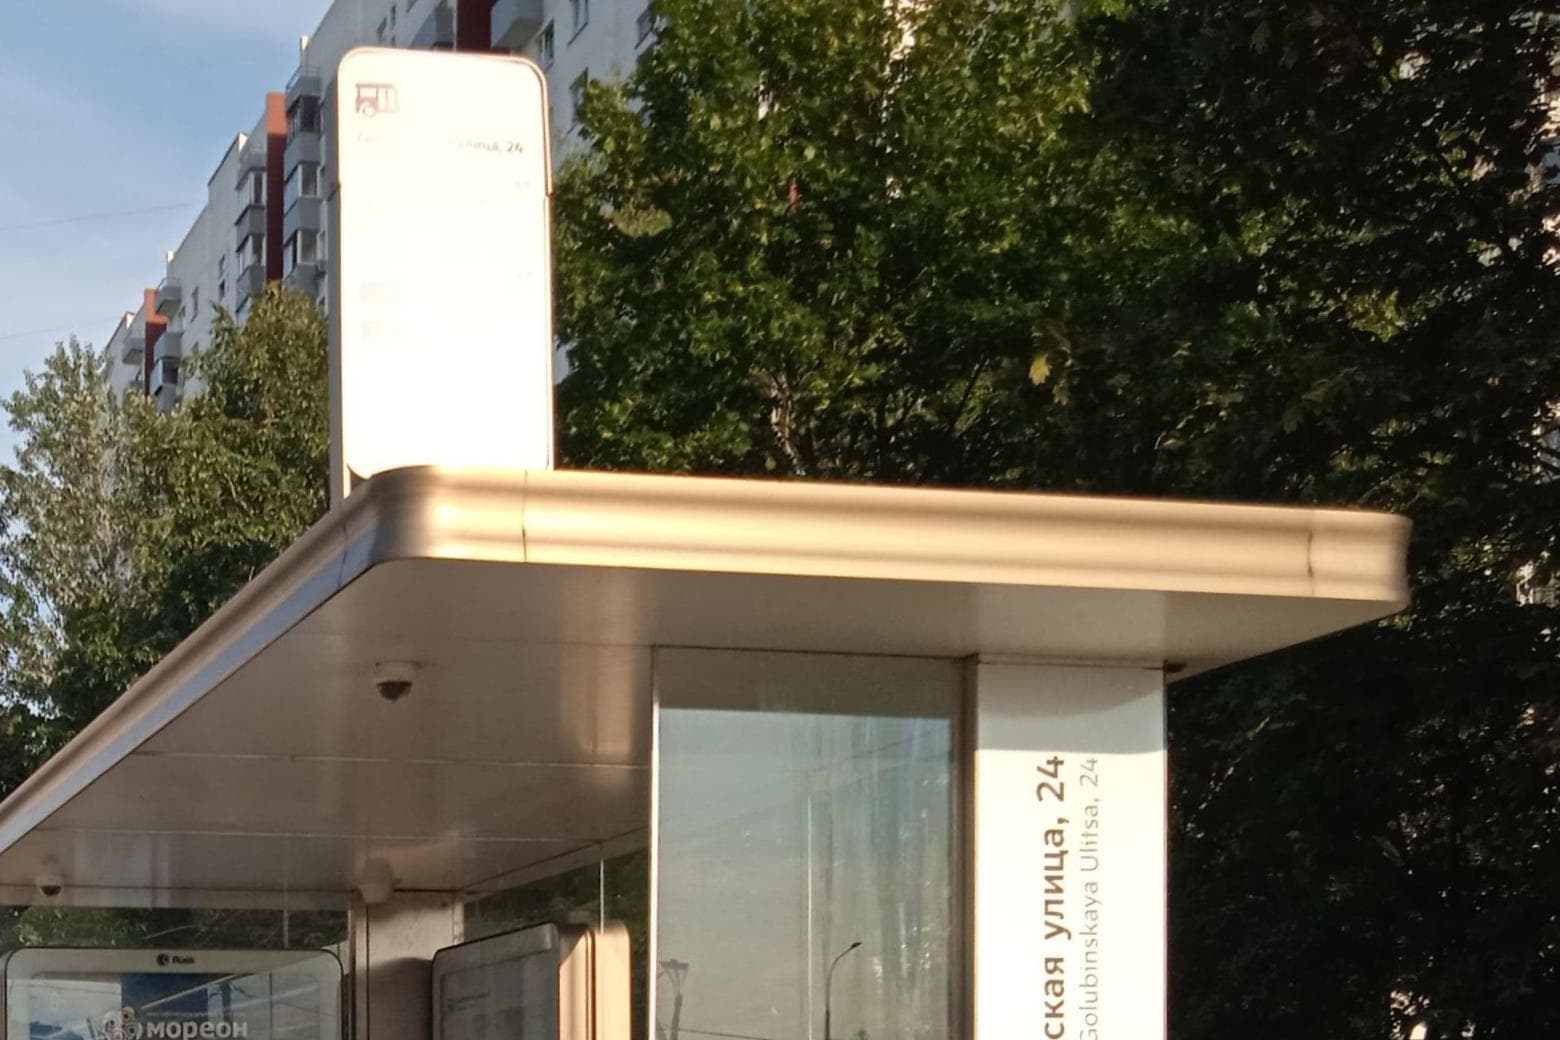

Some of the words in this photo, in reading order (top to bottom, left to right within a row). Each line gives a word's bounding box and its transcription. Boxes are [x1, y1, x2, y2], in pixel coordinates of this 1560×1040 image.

[506, 140, 524, 154] 24
[1035, 756, 1067, 803] 24
[1079, 757, 1099, 786] 24
[1078, 797, 1102, 872] Ulitsa,
[1042, 817, 1072, 941] улица,
